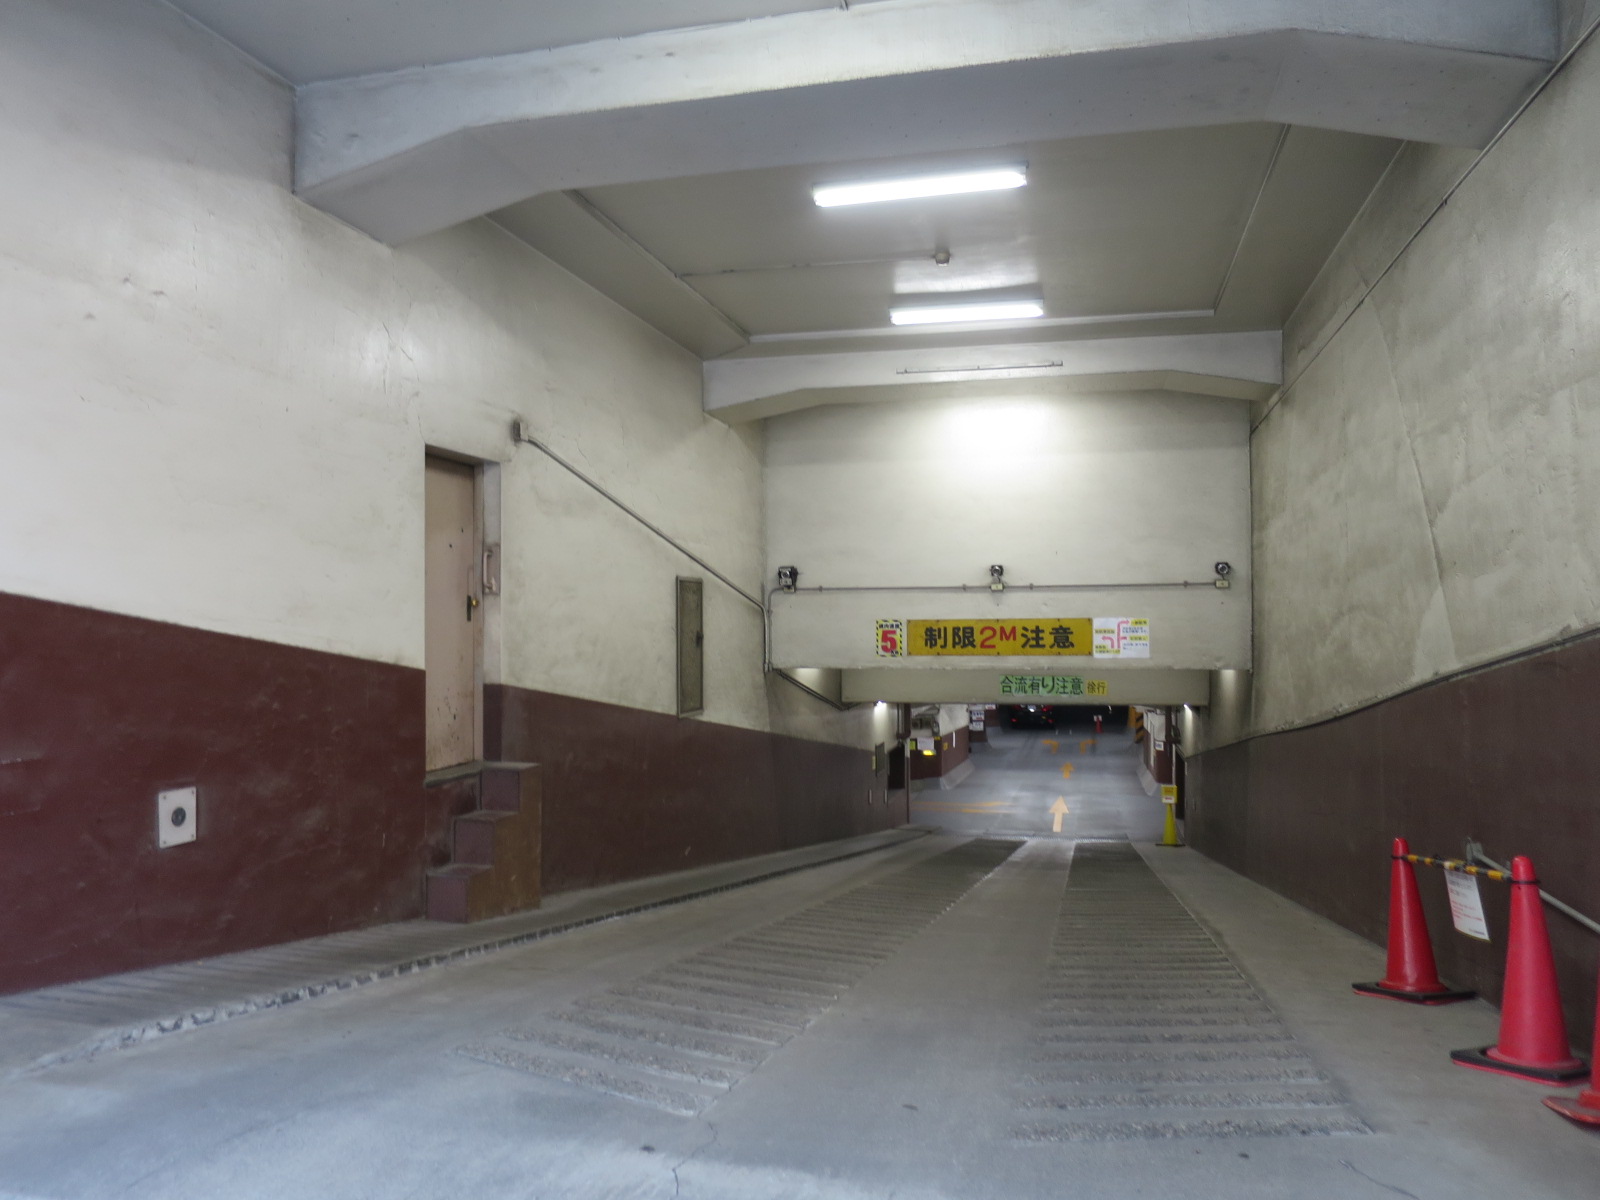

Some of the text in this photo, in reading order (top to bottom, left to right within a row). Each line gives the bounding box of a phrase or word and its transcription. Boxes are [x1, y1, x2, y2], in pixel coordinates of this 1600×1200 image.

[881, 630, 897, 653] 5
[924, 626, 1075, 649] 制限2M注意
[1001, 676, 1083, 695] 合流有り注意
[1087, 680, 1107, 694] 徐行
